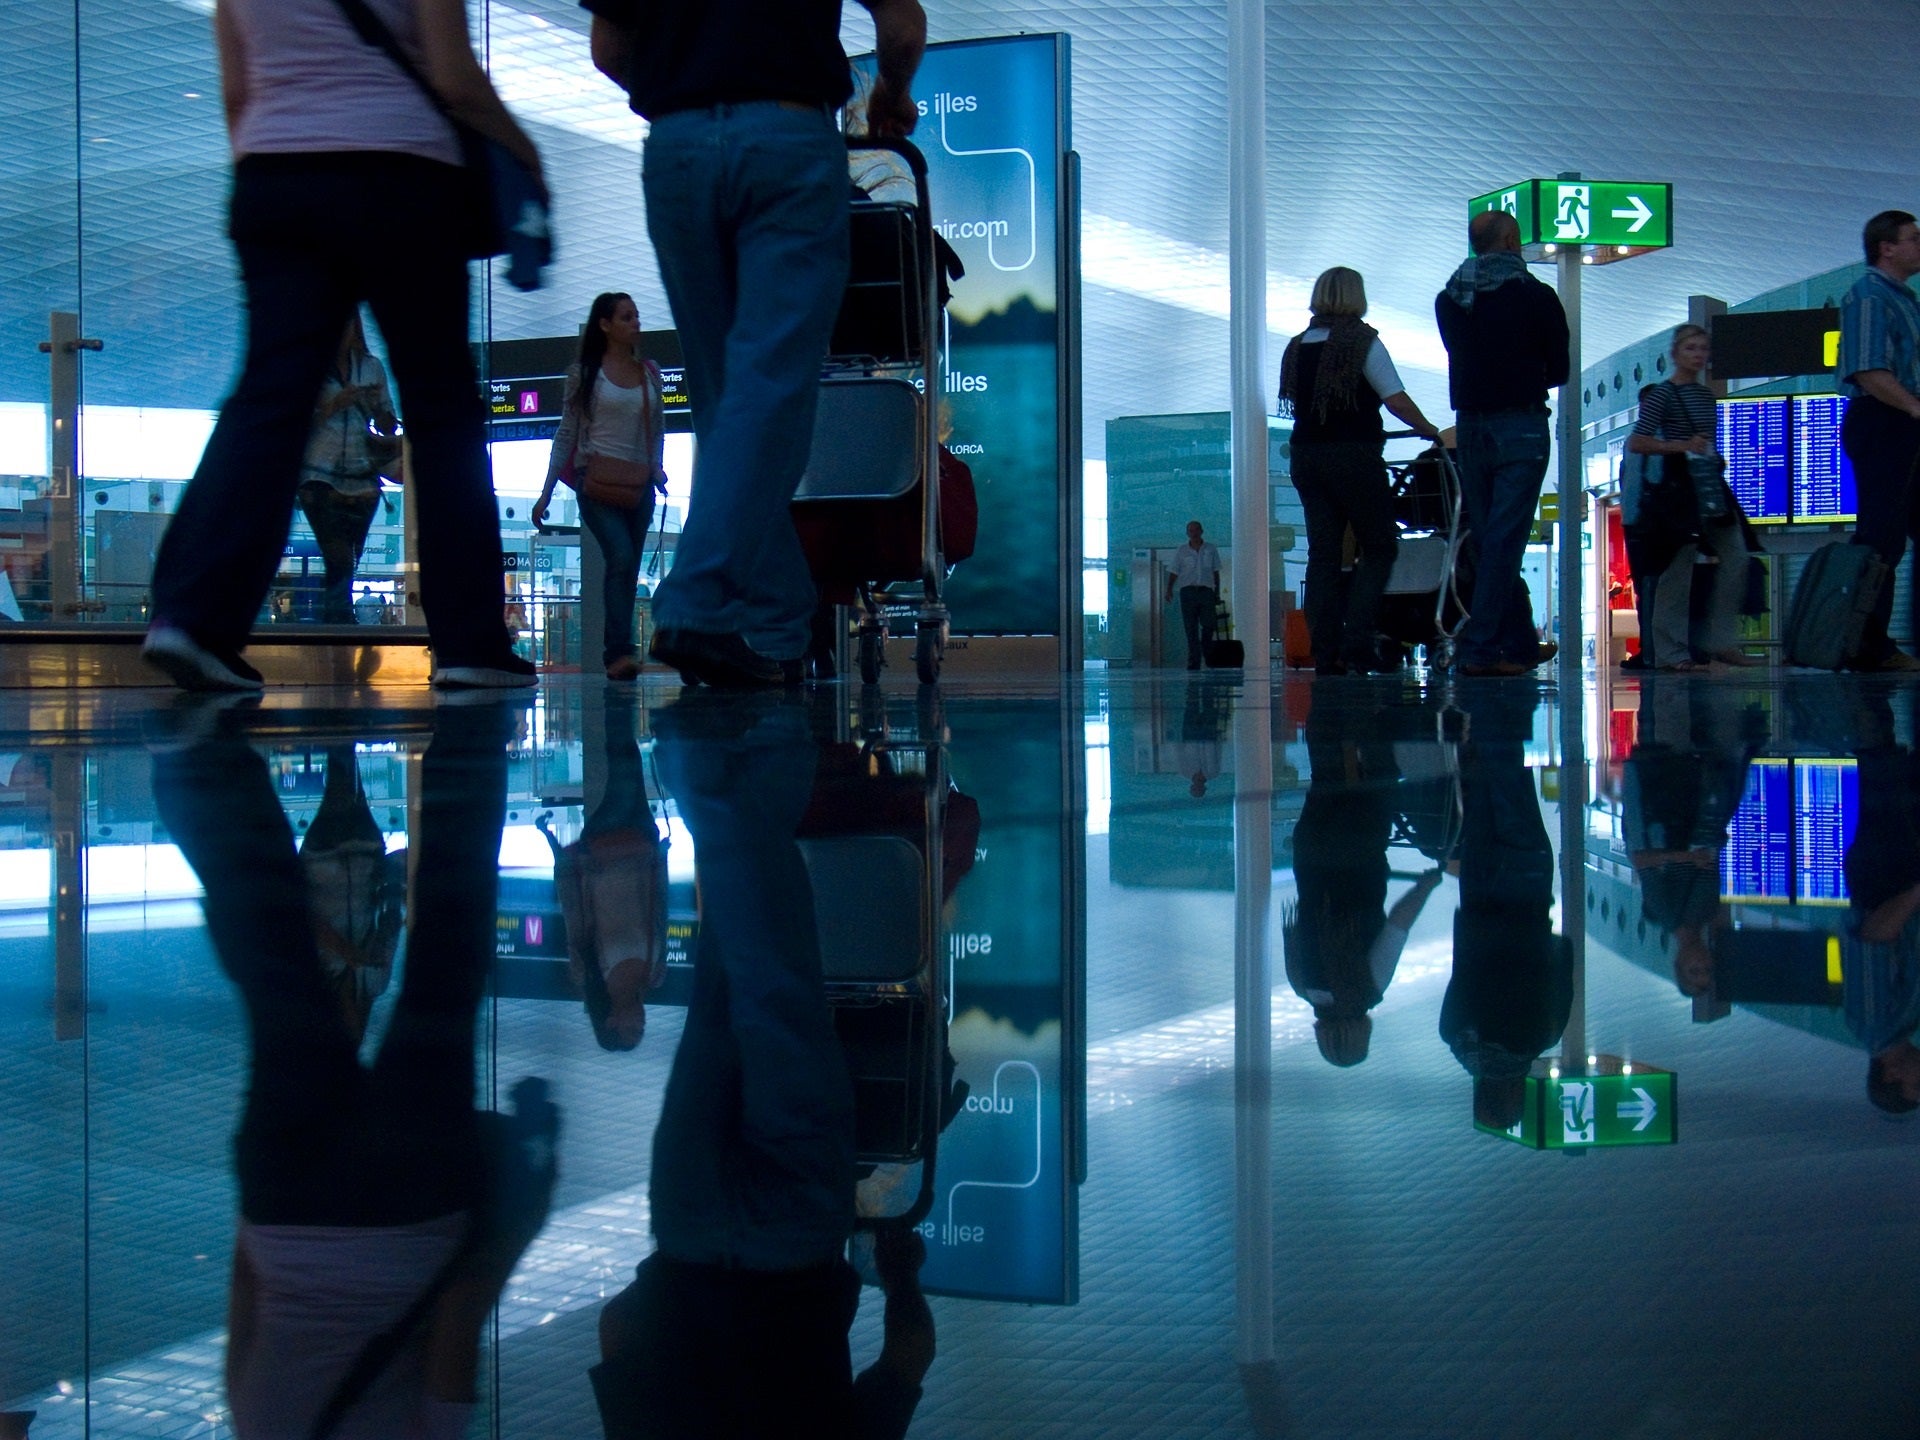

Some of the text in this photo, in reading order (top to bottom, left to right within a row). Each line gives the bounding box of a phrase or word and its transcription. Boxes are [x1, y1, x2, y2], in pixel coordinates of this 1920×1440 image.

[934, 92, 978, 114] illes
[945, 371, 988, 393] illes
[523, 394, 535, 410] A
[517, 425, 536, 438] Sky
[944, 444, 984, 455] LORCA
